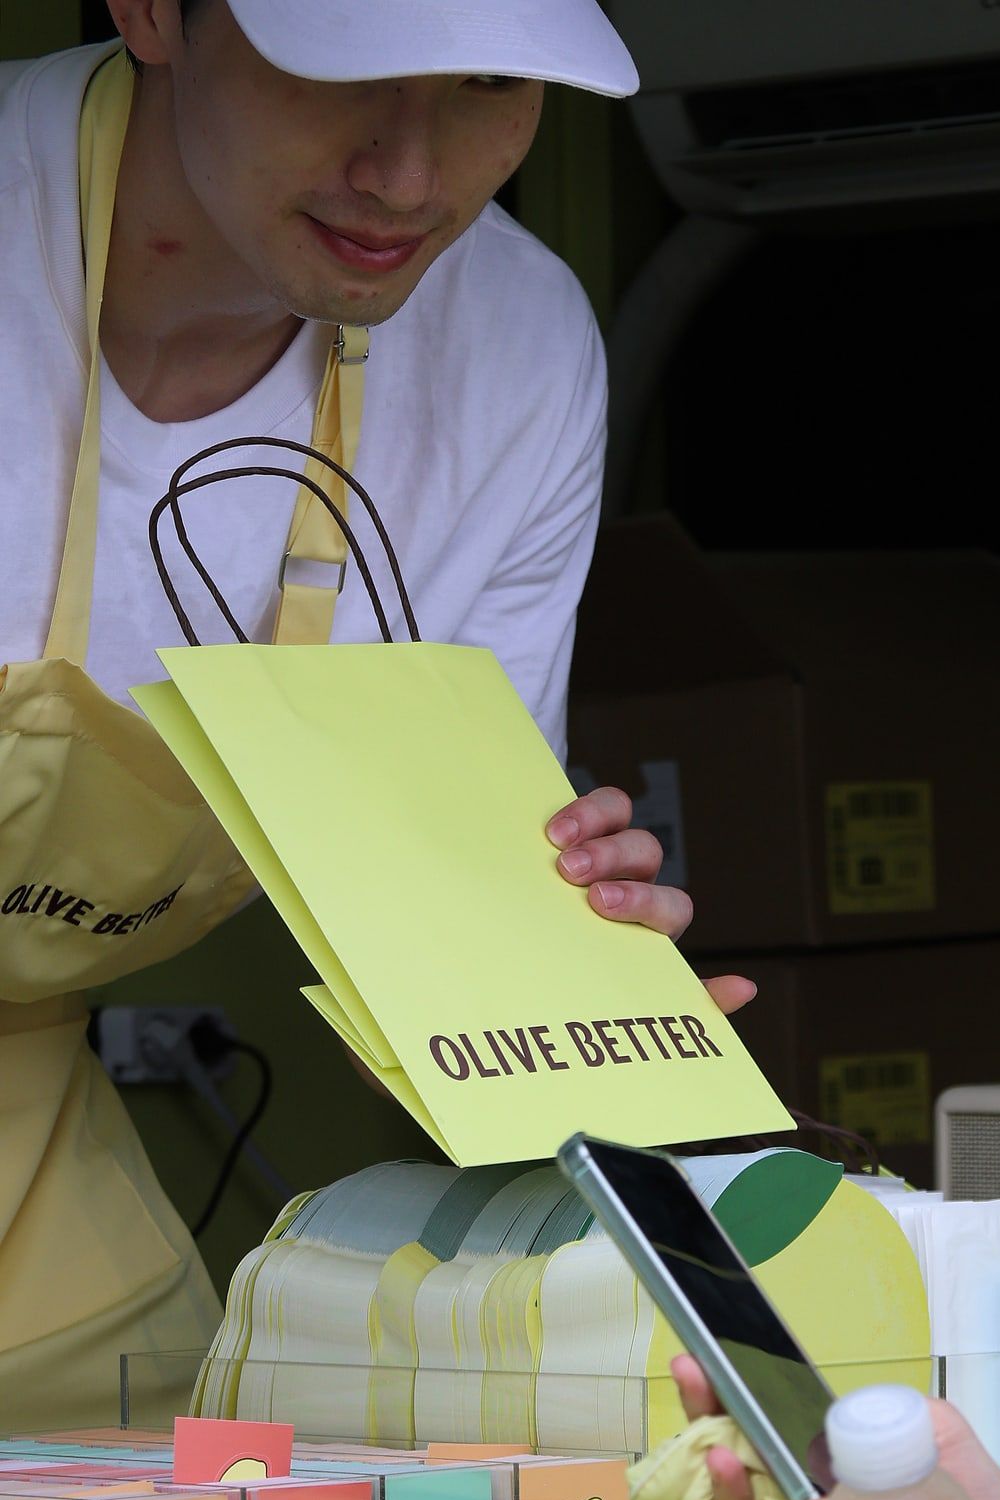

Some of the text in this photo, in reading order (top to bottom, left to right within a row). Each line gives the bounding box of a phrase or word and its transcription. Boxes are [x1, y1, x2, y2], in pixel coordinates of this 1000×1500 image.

[1, 884, 95, 926] OLIVE
[429, 1014, 724, 1081] OLIVE BETTER
